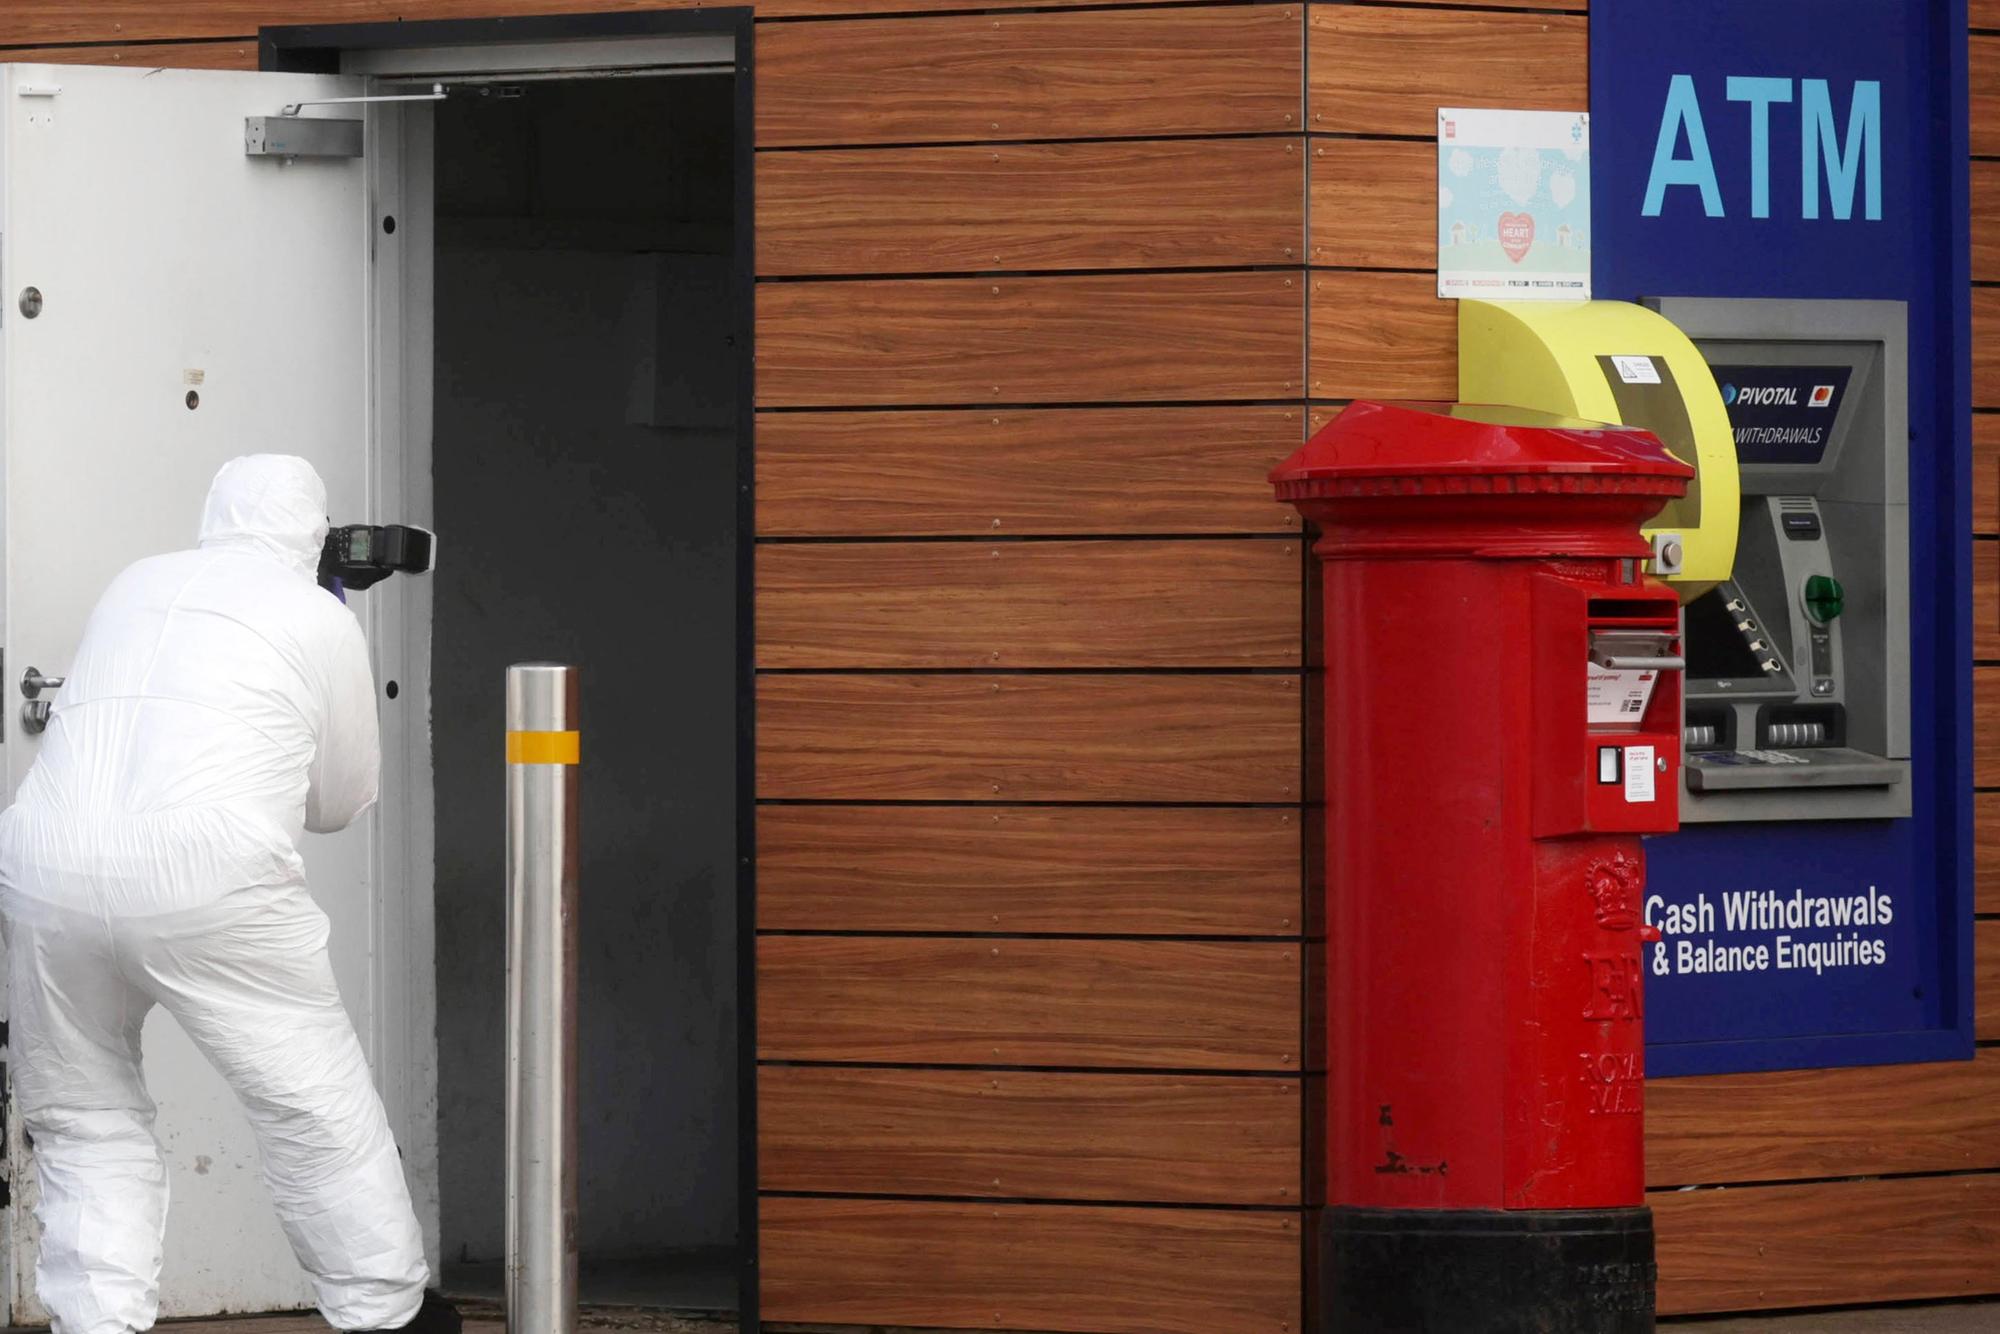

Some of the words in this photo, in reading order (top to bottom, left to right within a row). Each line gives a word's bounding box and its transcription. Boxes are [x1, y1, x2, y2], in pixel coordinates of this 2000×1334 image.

[1641, 74, 1882, 220] ATM
[1503, 227, 1529, 238] HEART
[1737, 387, 1798, 405] PIVOTAL
[1735, 427, 1822, 444] WITHDRAWALS
[1645, 893, 1715, 935] Cash
[1722, 885, 1893, 932] Withdrawals
[1652, 941, 1670, 976] &
[1676, 939, 1769, 974] Balance
[1776, 932, 1886, 976] Enquiries
